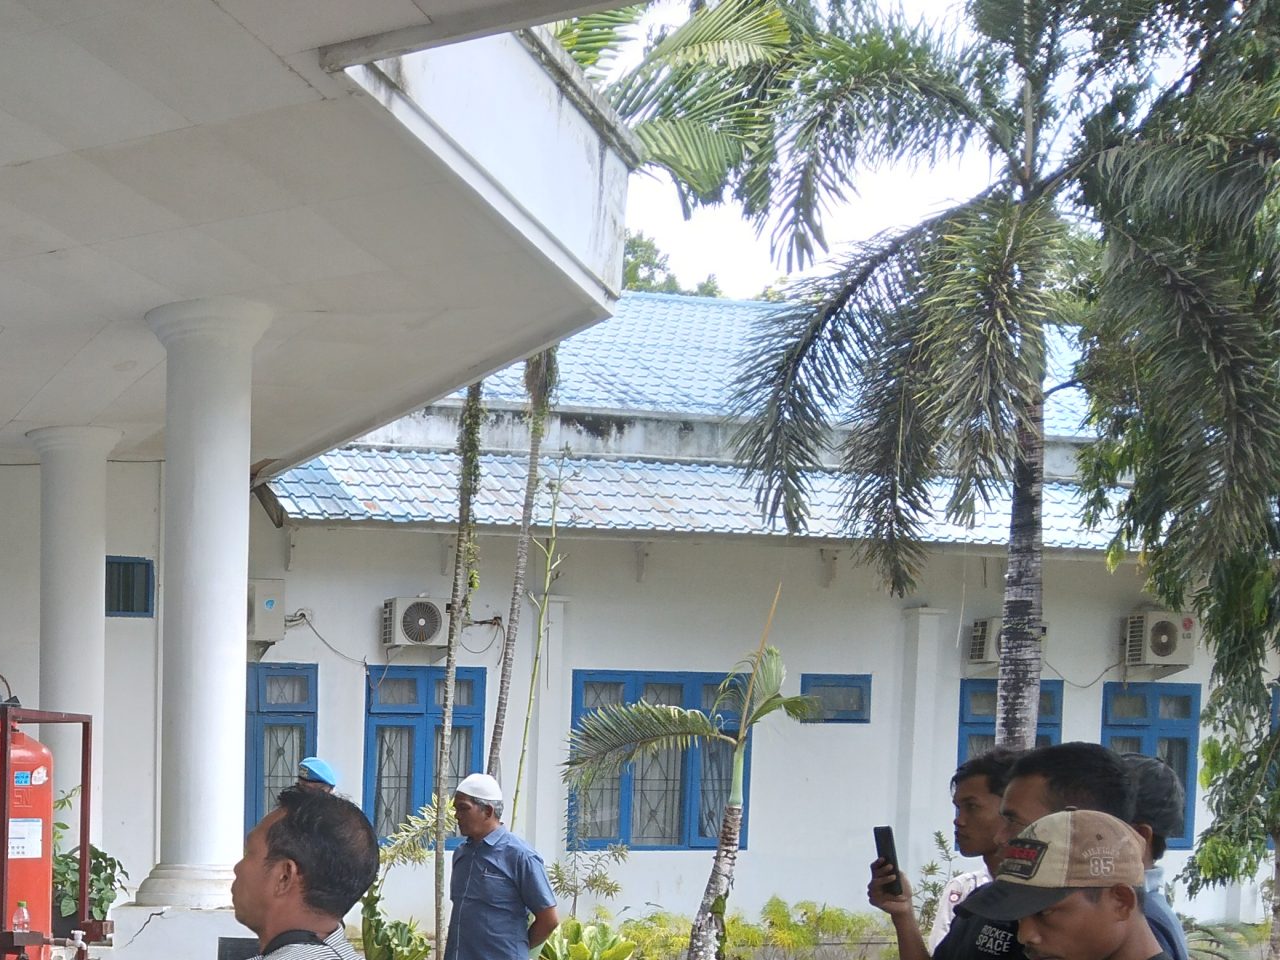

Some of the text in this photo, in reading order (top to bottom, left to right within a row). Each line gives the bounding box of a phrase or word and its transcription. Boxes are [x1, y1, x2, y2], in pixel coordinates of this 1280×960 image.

[1182, 632, 1192, 640] LG
[1090, 856, 1115, 876] 85
[981, 924, 1014, 941] ROCKET
[976, 934, 1011, 953] SPACE
